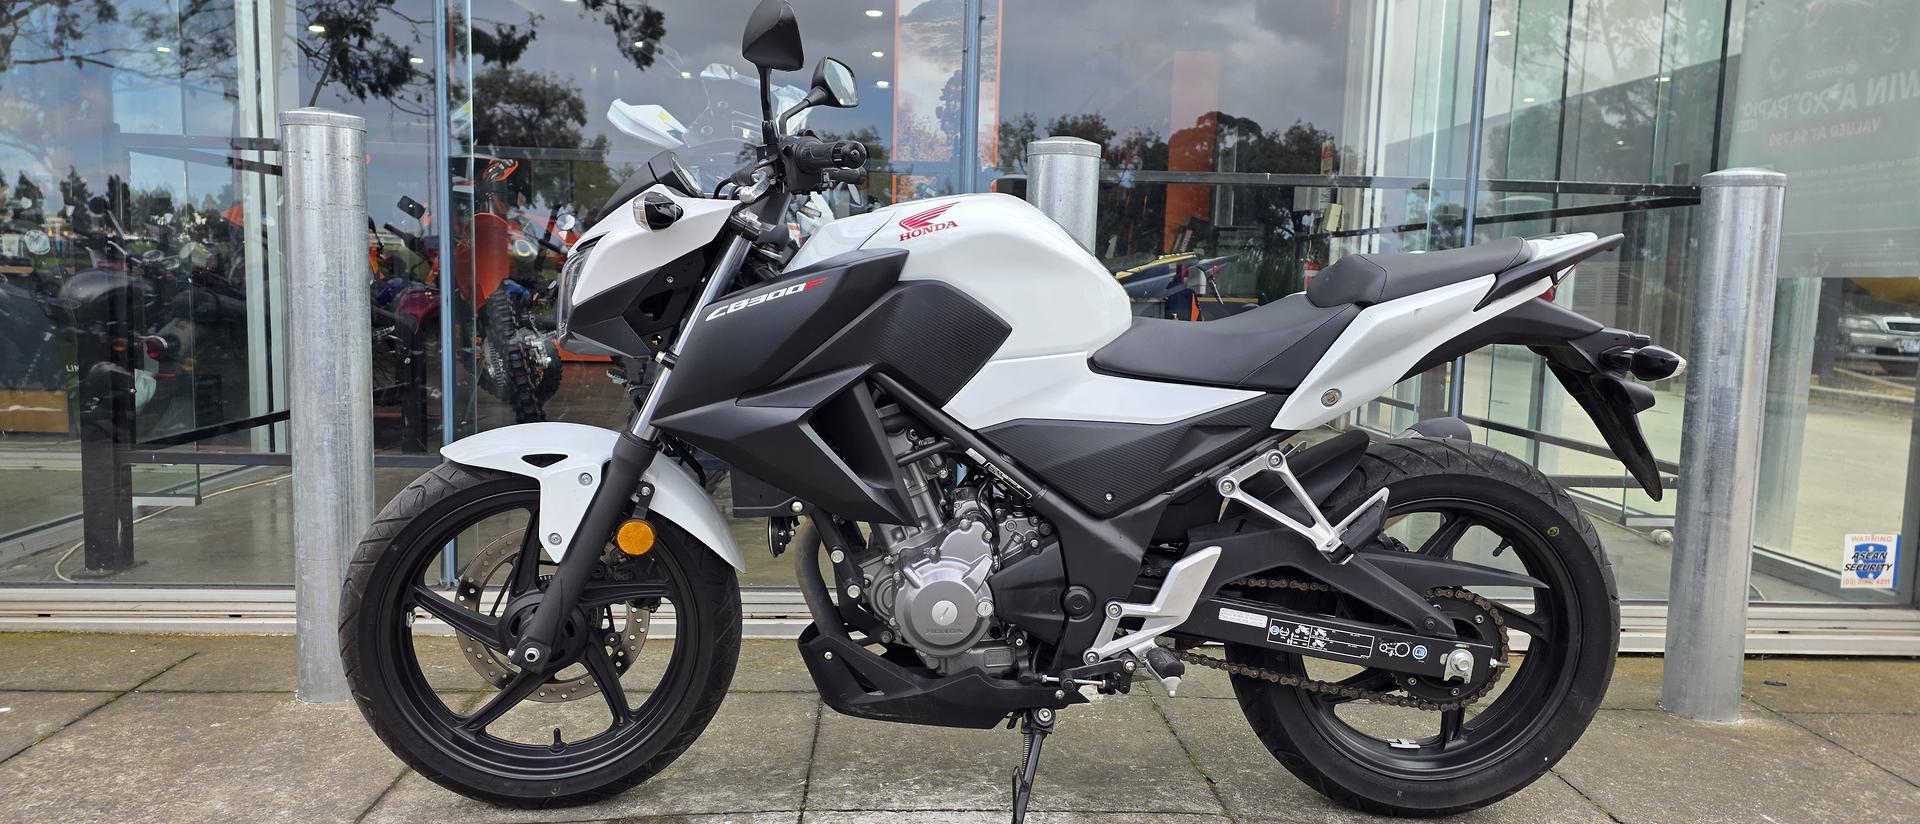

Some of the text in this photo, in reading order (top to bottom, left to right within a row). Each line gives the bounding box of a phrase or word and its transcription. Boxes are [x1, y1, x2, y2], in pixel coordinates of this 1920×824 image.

[899, 220, 959, 242] HONDA
[705, 276, 829, 322] CB300F
[1851, 551, 1888, 560] ASCAN
[1843, 563, 1893, 572] SECURITY
[925, 627, 963, 636] HONDA
